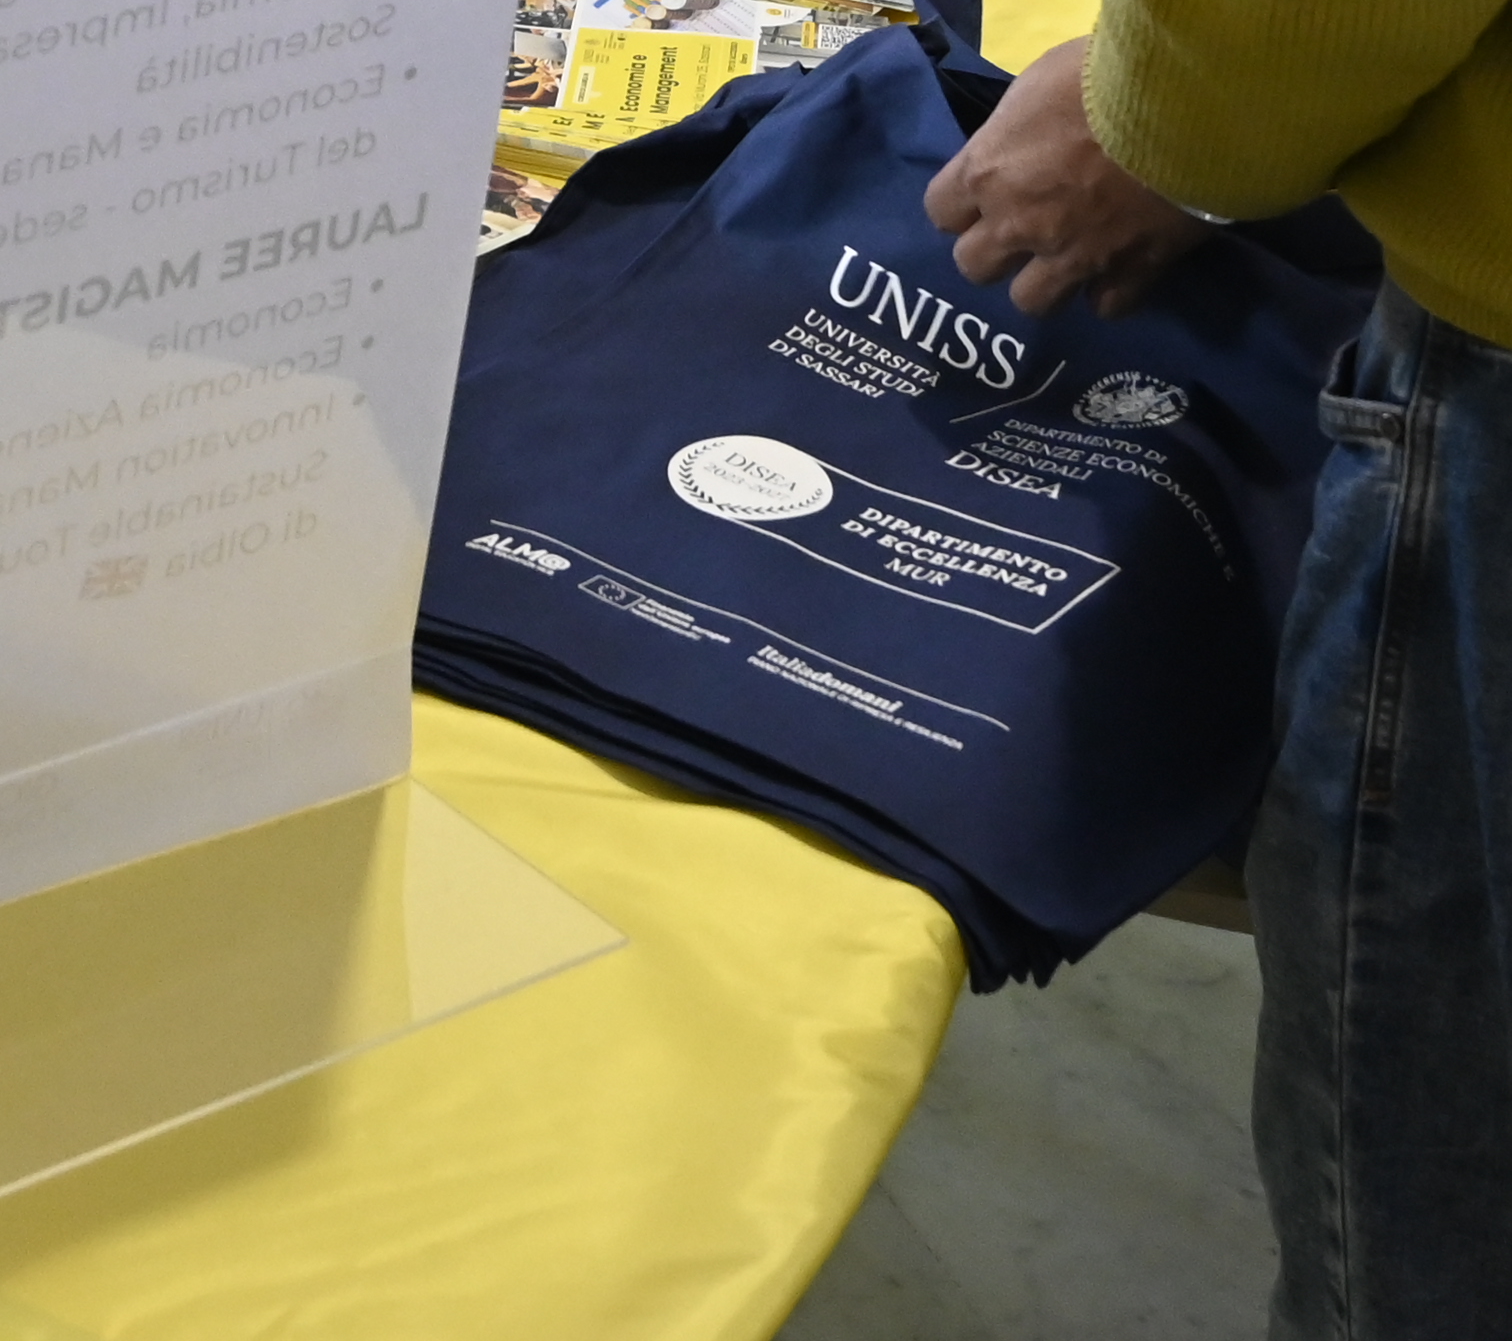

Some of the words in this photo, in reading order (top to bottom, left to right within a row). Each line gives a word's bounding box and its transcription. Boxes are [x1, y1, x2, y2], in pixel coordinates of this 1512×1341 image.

[620, 62, 647, 113] Economia
[650, 46, 678, 115] Management
[804, 308, 941, 388] UNIVERSITÀ
[830, 245, 1025, 389] UNISS
[768, 339, 797, 357] DI
[796, 352, 885, 399] SASSARI
[784, 325, 854, 367] DEGLI
[854, 360, 925, 397] STUDI
[723, 451, 798, 494] DISEA
[971, 440, 1093, 482] AZIENDALI
[1004, 419, 1142, 455] DIPARTIMENTO
[1143, 449, 1168, 465] DI
[944, 450, 1063, 500] DISEA
[988, 430, 1085, 463] SCIENZE
[1086, 453, 1225, 559] ECONOMICHE
[472, 533, 571, 571] ALM@
[841, 519, 875, 539] DI
[878, 533, 1049, 598] ECCELLENZA
[859, 507, 1068, 582] DIPARTIMENTO
[884, 557, 951, 587] MUR
[756, 645, 904, 713] Italiadomani
